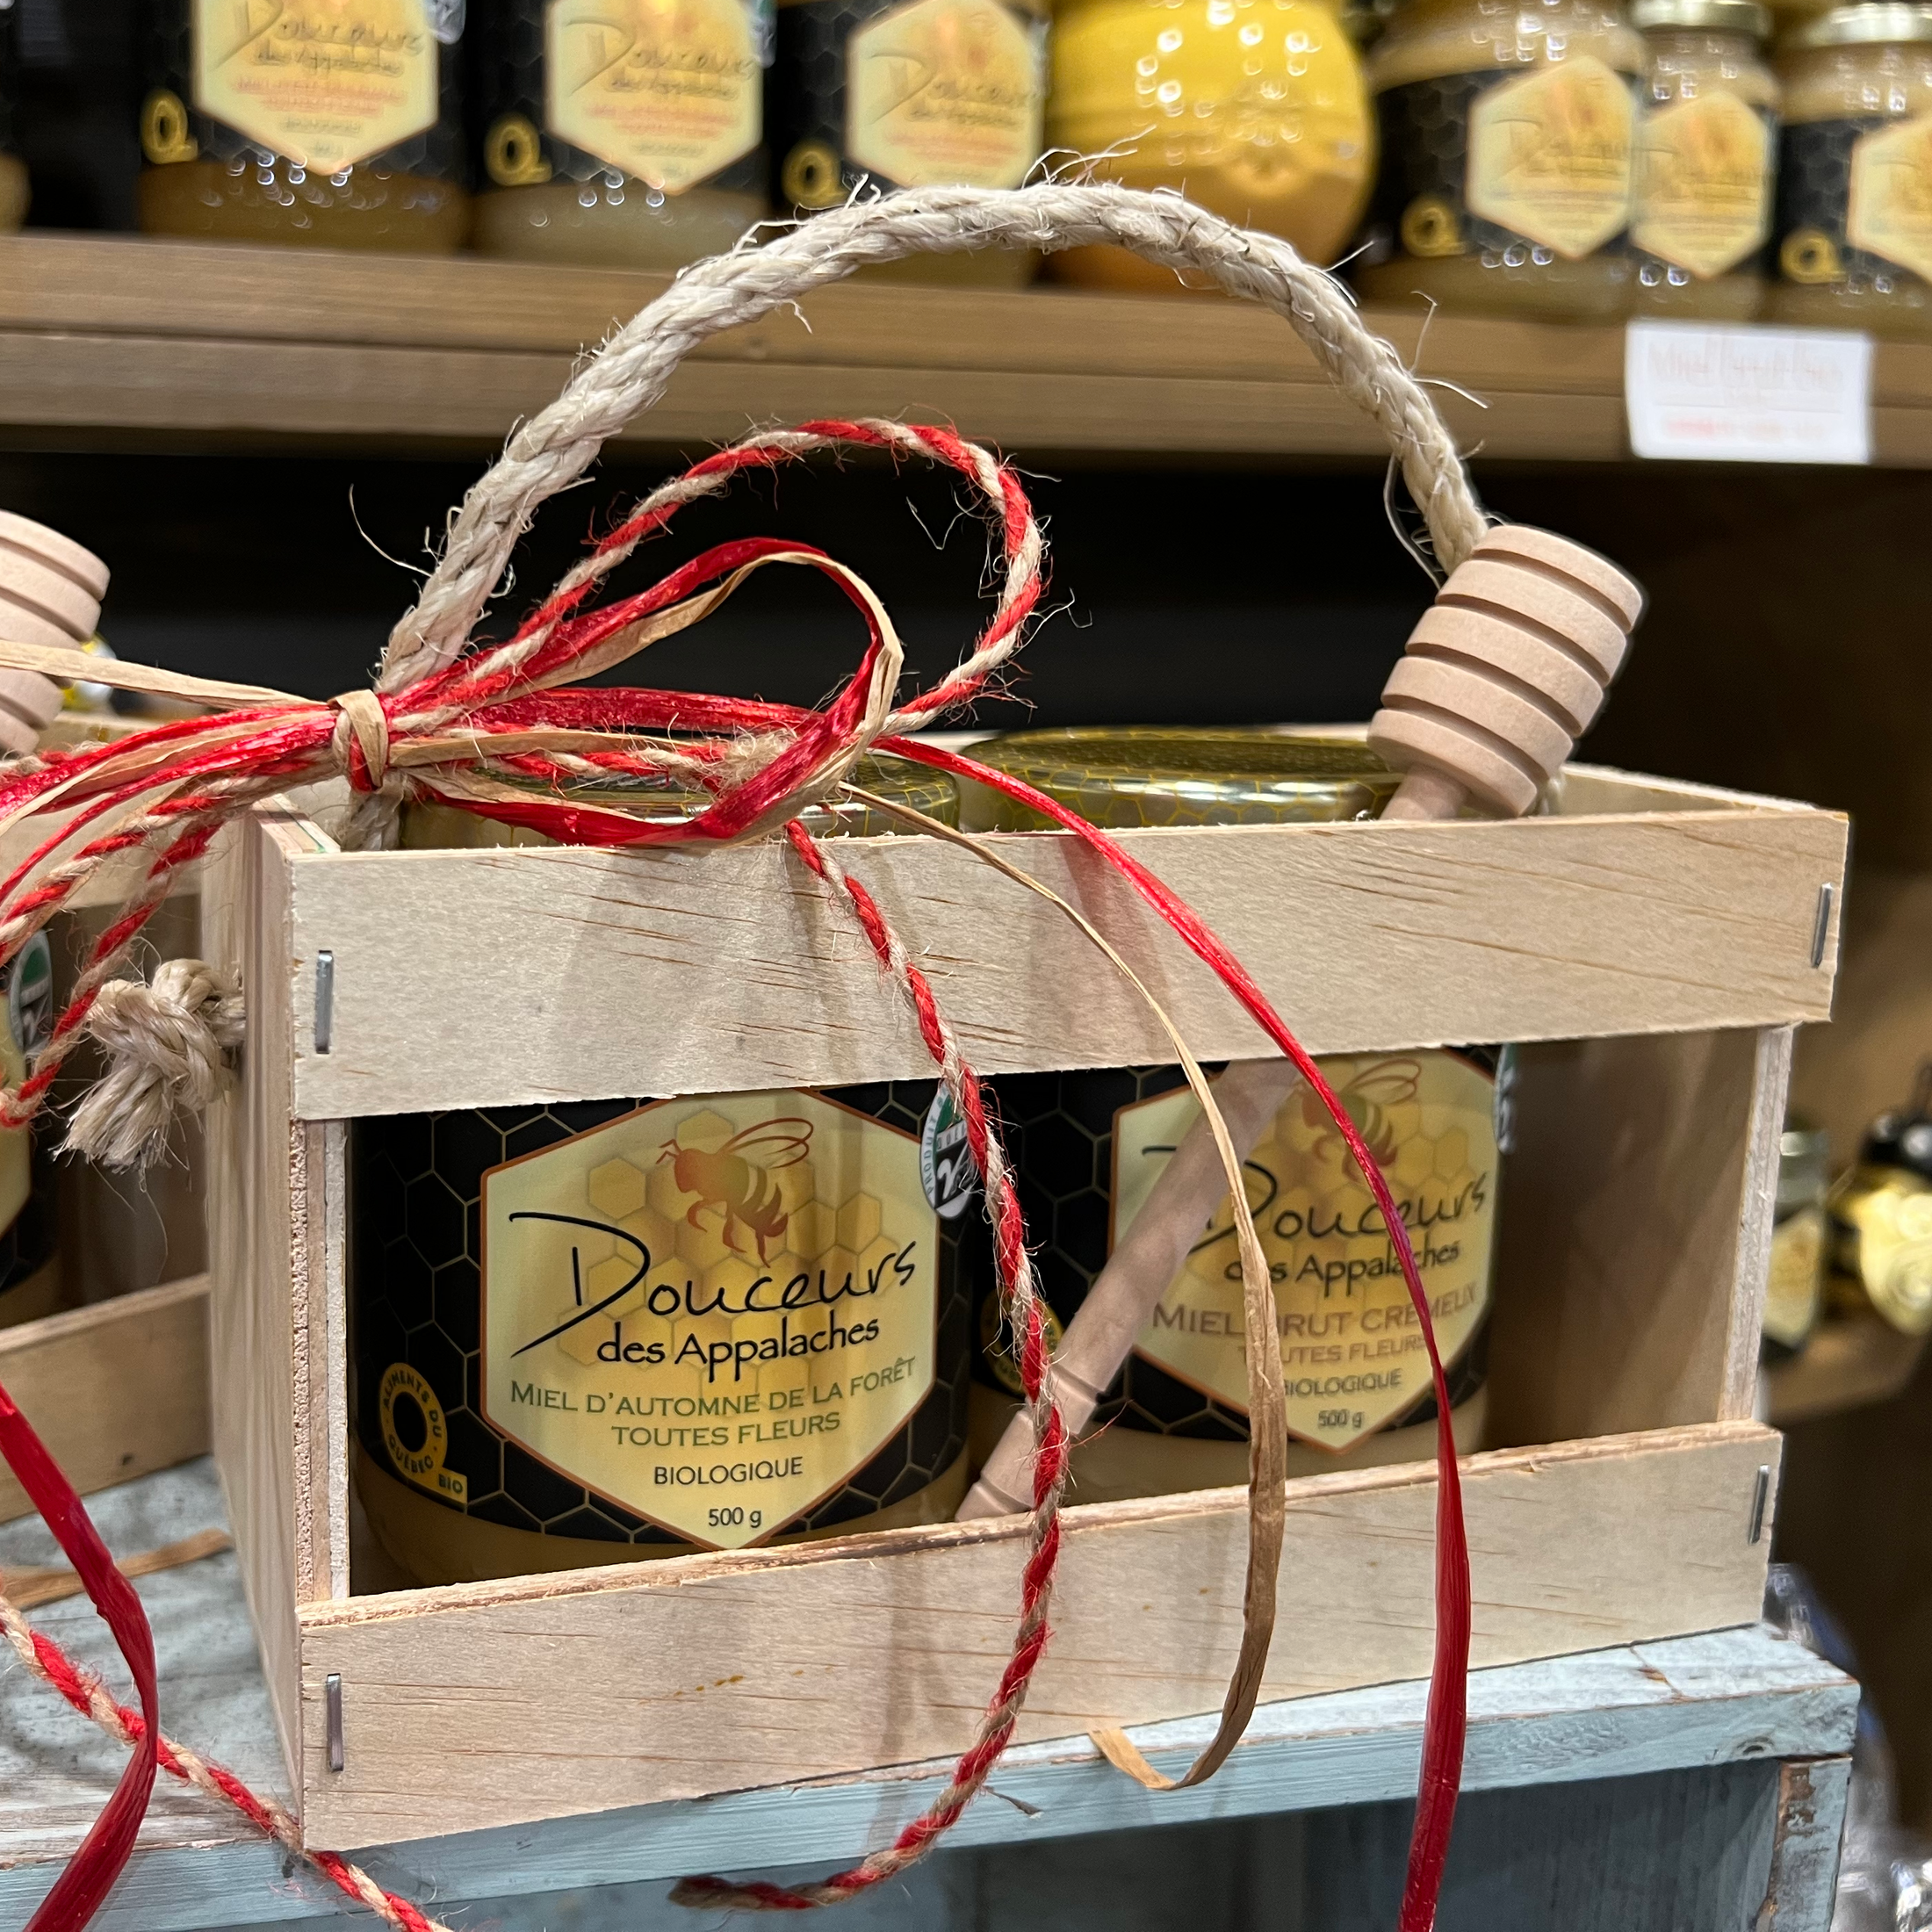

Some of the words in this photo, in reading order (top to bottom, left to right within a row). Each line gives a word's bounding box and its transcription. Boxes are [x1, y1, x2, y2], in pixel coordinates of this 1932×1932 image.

[509, 1212, 917, 1359] Douceurs
[1152, 1301, 1245, 1336] MIEL
[597, 1321, 665, 1364] des
[674, 1310, 879, 1383] Appalaches
[511, 1381, 579, 1412] MIEL
[587, 1392, 760, 1417] D'AUTOMNE
[768, 1389, 804, 1411] DE
[813, 1381, 843, 1404] LA
[850, 1356, 916, 1396] FORÊT
[611, 1424, 729, 1447] TOUTES
[738, 1411, 840, 1444] FLEURS
[1318, 1409, 1350, 1429] 500
[1352, 1410, 1364, 1429] g
[438, 1473, 464, 1494] BIO
[653, 1456, 804, 1485] BIOLOGIQUE
[708, 1507, 744, 1528] 500
[749, 1509, 762, 1528] g
